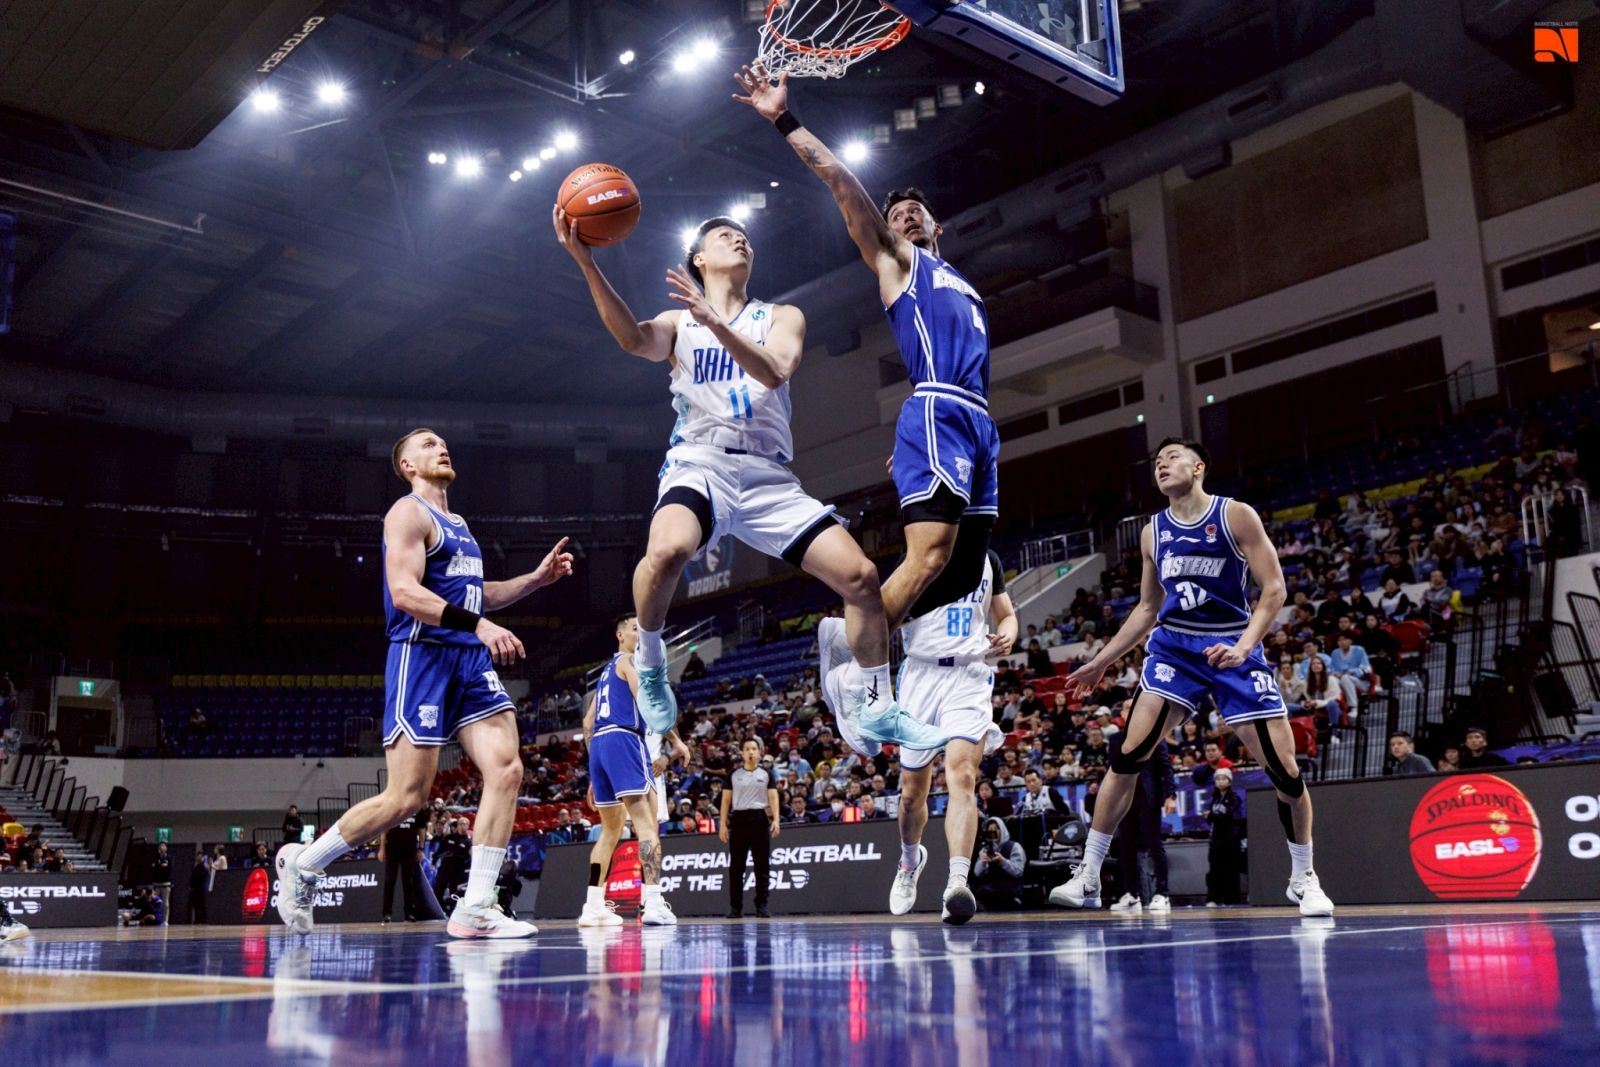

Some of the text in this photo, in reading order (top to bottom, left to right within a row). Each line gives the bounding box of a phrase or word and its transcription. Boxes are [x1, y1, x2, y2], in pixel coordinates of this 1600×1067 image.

[587, 190, 623, 205] EASL
[727, 383, 753, 420] 11
[1175, 581, 1212, 611] 32
[947, 607, 973, 636] 88
[1250, 670, 1277, 693] 32
[1427, 793, 1523, 824] SPALDING
[745, 842, 881, 867] SKETBALL
[1434, 838, 1504, 860] EASL
[609, 879, 636, 892] EASL
[660, 870, 791, 893] OF THE ASL
[312, 893, 335, 907] ASL
